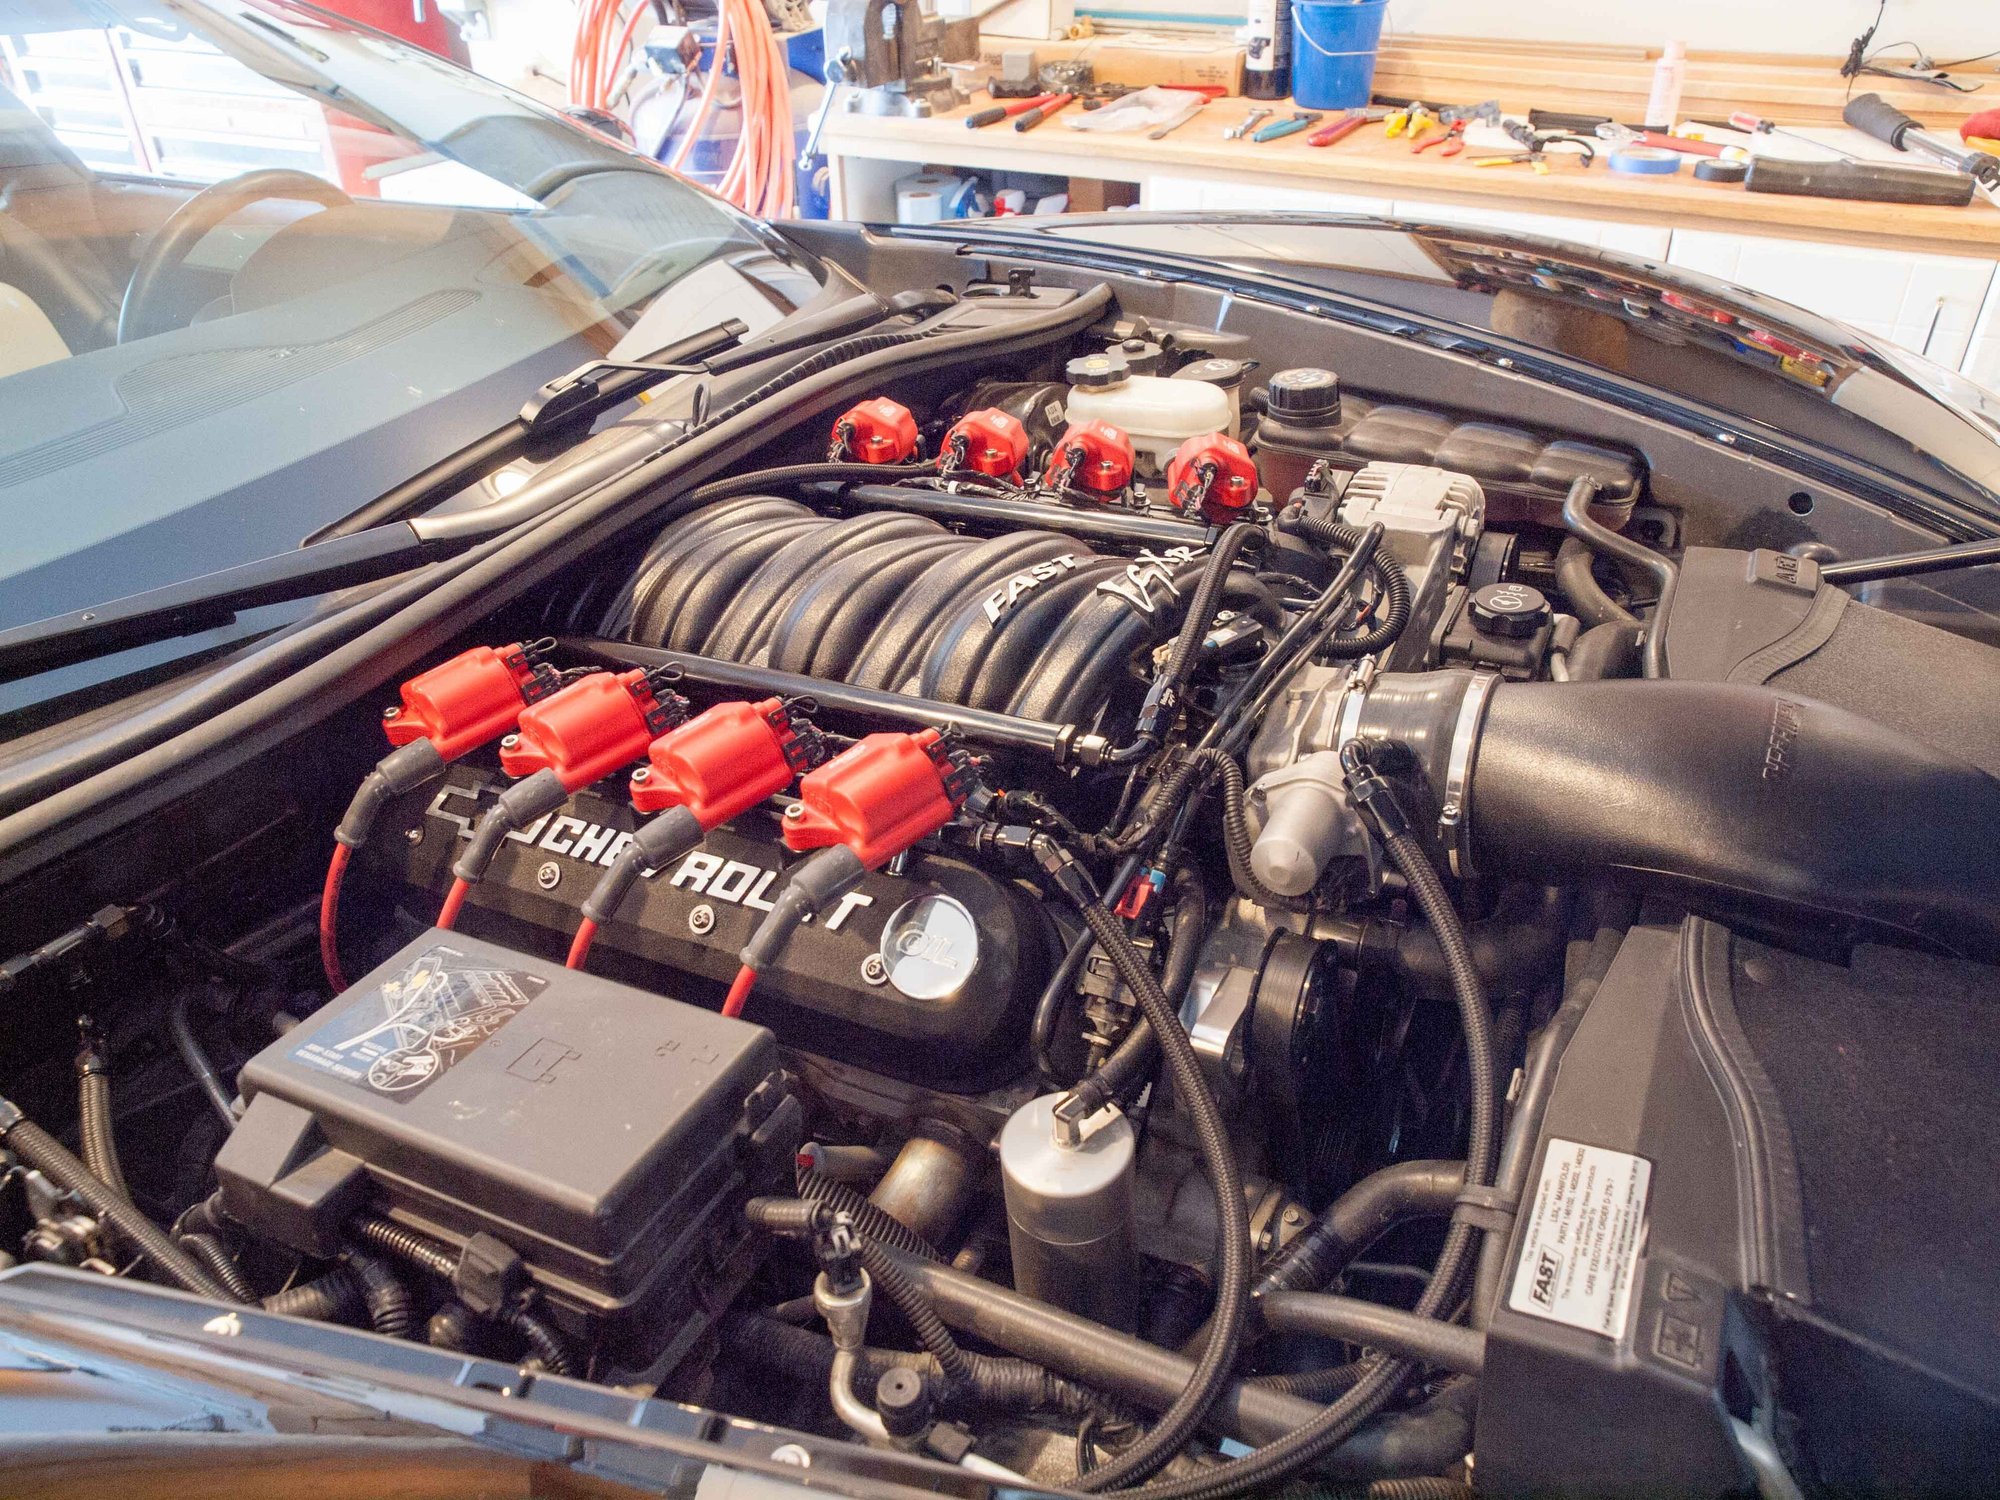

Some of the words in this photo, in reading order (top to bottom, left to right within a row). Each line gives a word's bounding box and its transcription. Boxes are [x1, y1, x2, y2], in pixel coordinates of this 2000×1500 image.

[983, 553, 1075, 625] FAST
[539, 815, 873, 931] CHEROLT
[895, 927, 958, 970] OIL
[1531, 1251, 1557, 1304] FAST
